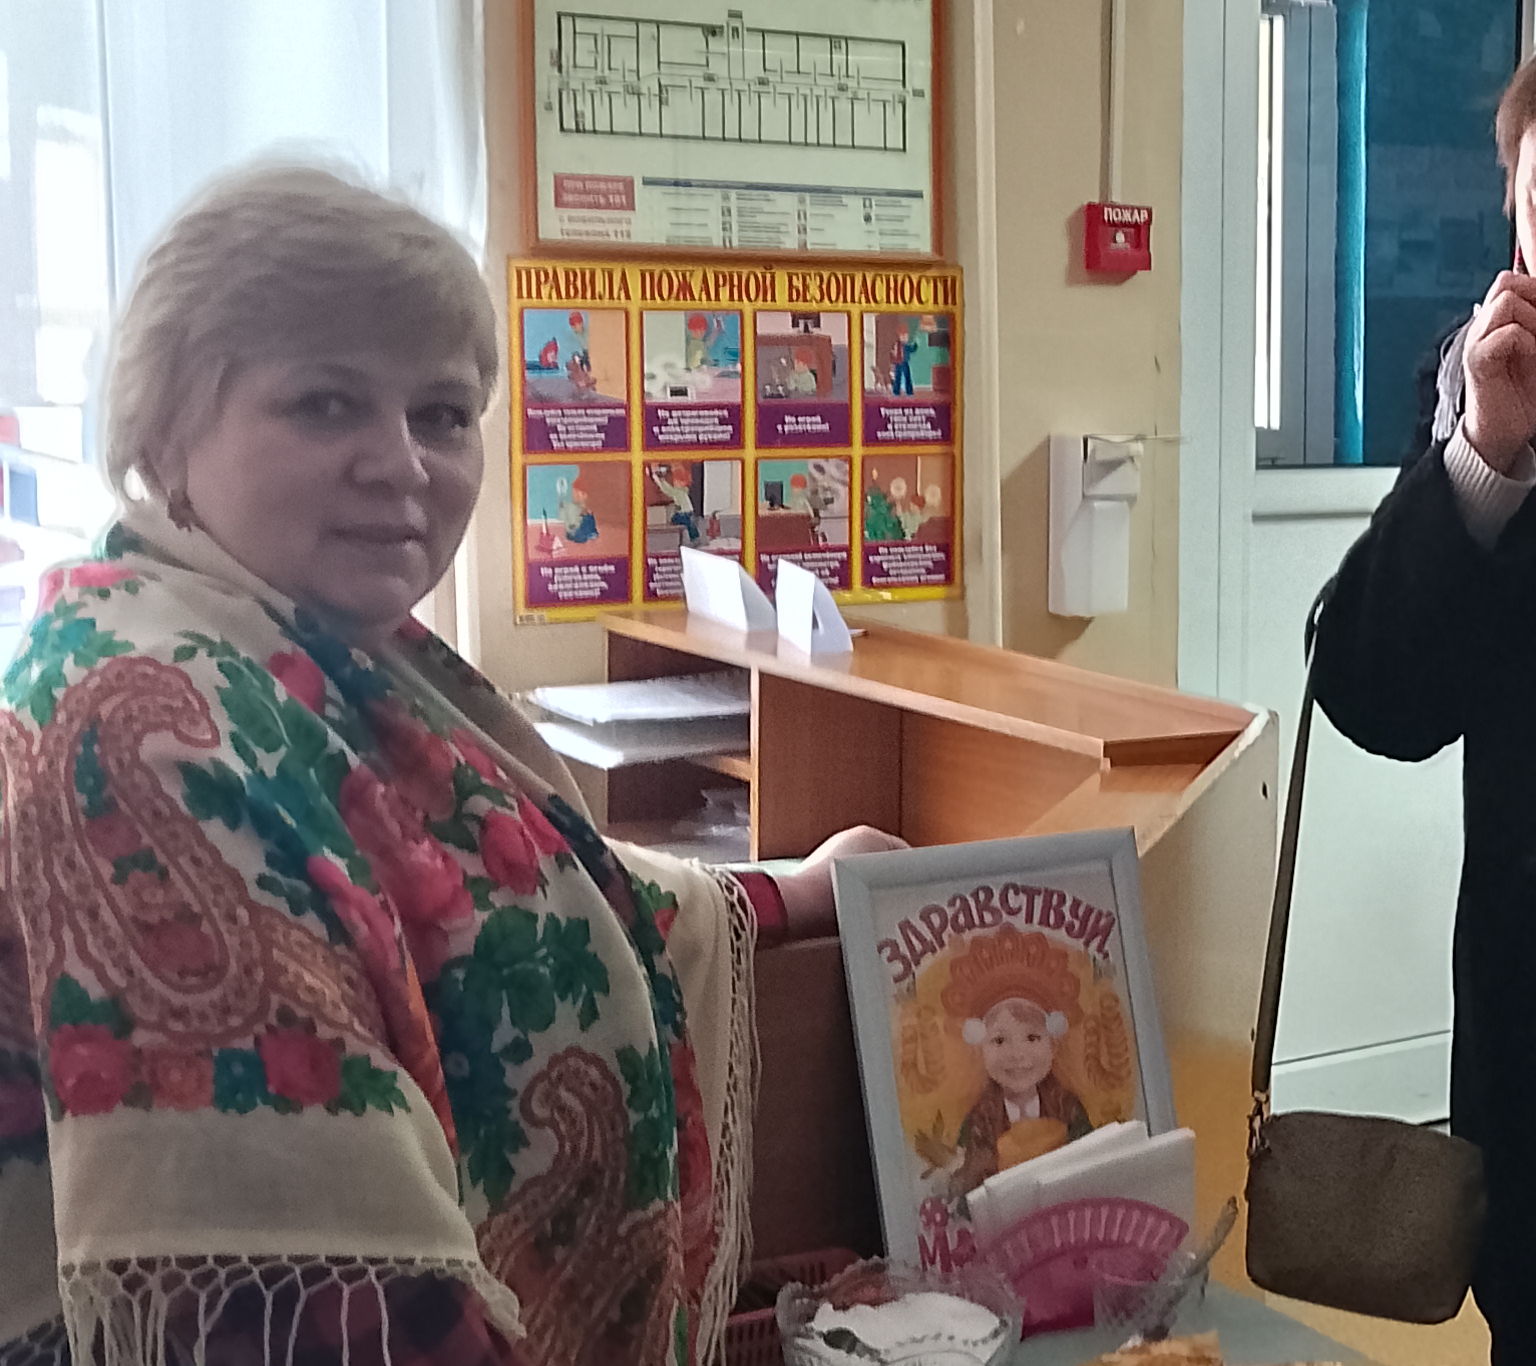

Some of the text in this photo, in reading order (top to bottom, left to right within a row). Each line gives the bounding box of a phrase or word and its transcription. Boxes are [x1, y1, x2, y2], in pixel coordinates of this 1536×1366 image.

[1103, 206, 1149, 225] ПОЖАР
[515, 265, 958, 306] ПРАВИЛА ПОЖАРНОЙ БЕЗОПАСНОСТИ
